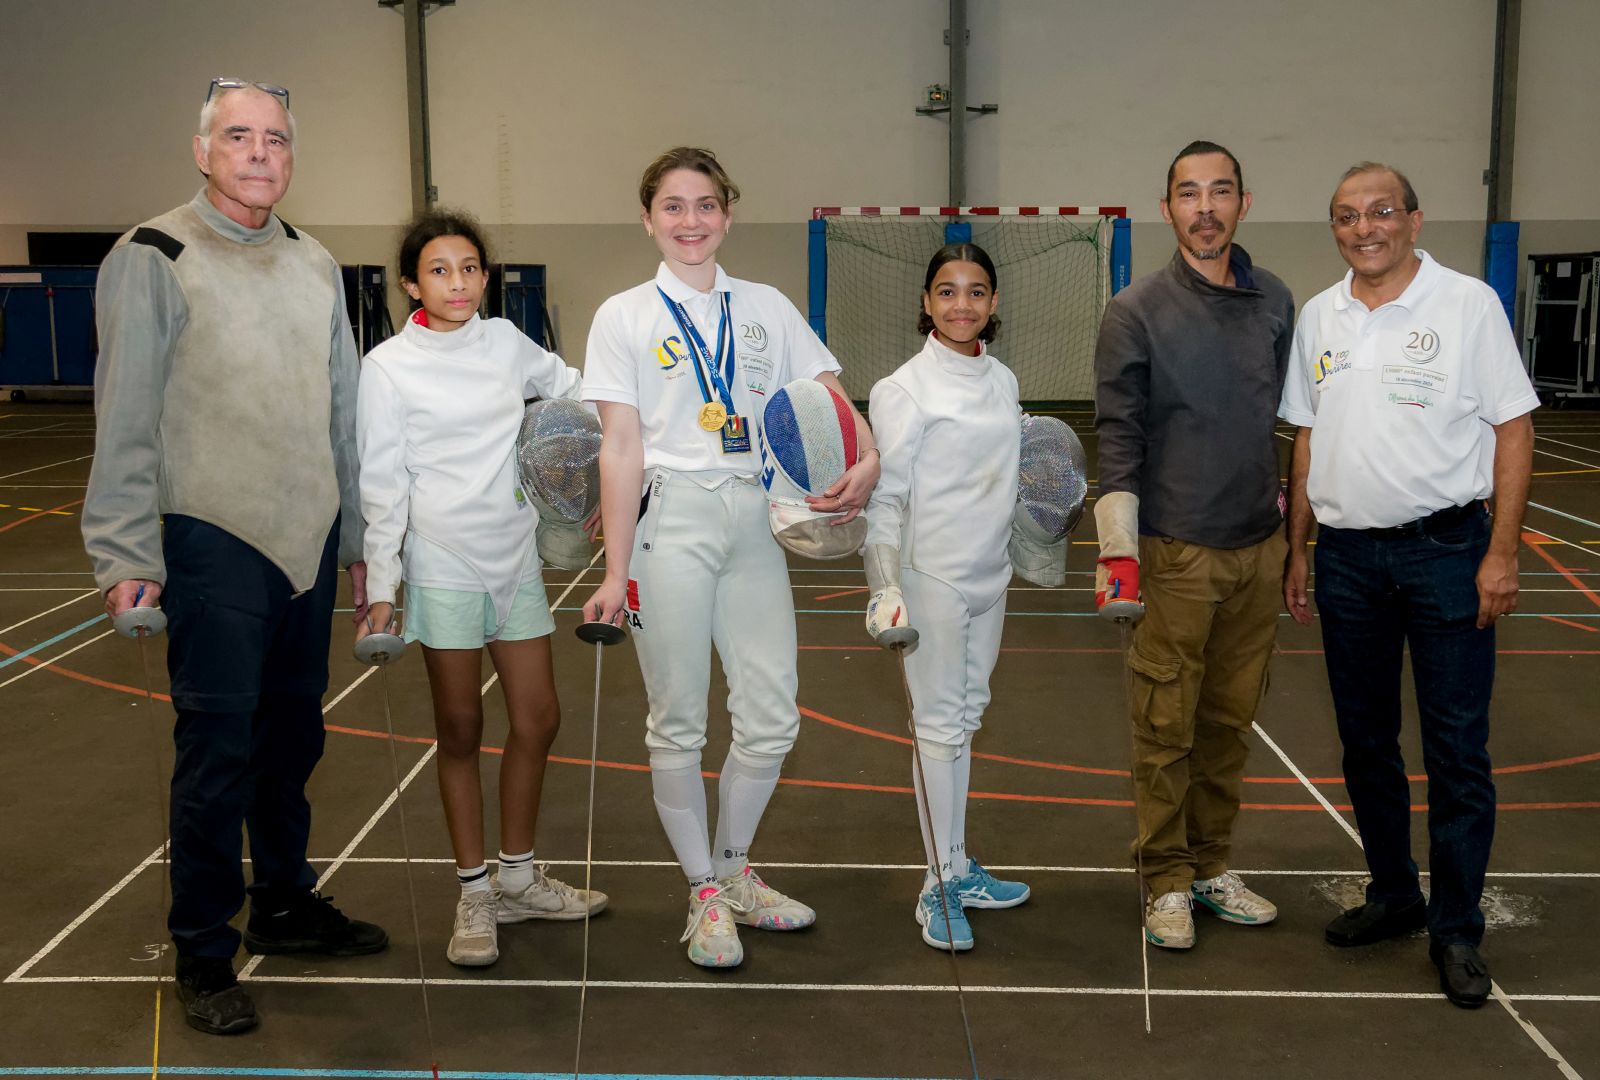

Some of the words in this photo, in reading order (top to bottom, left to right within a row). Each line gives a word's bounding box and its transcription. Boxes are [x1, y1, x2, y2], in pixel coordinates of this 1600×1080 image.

[740, 323, 762, 341] 20
[1406, 331, 1434, 352] 20
[700, 346, 721, 379] ESCRIME
[653, 480, 663, 497] Paul
